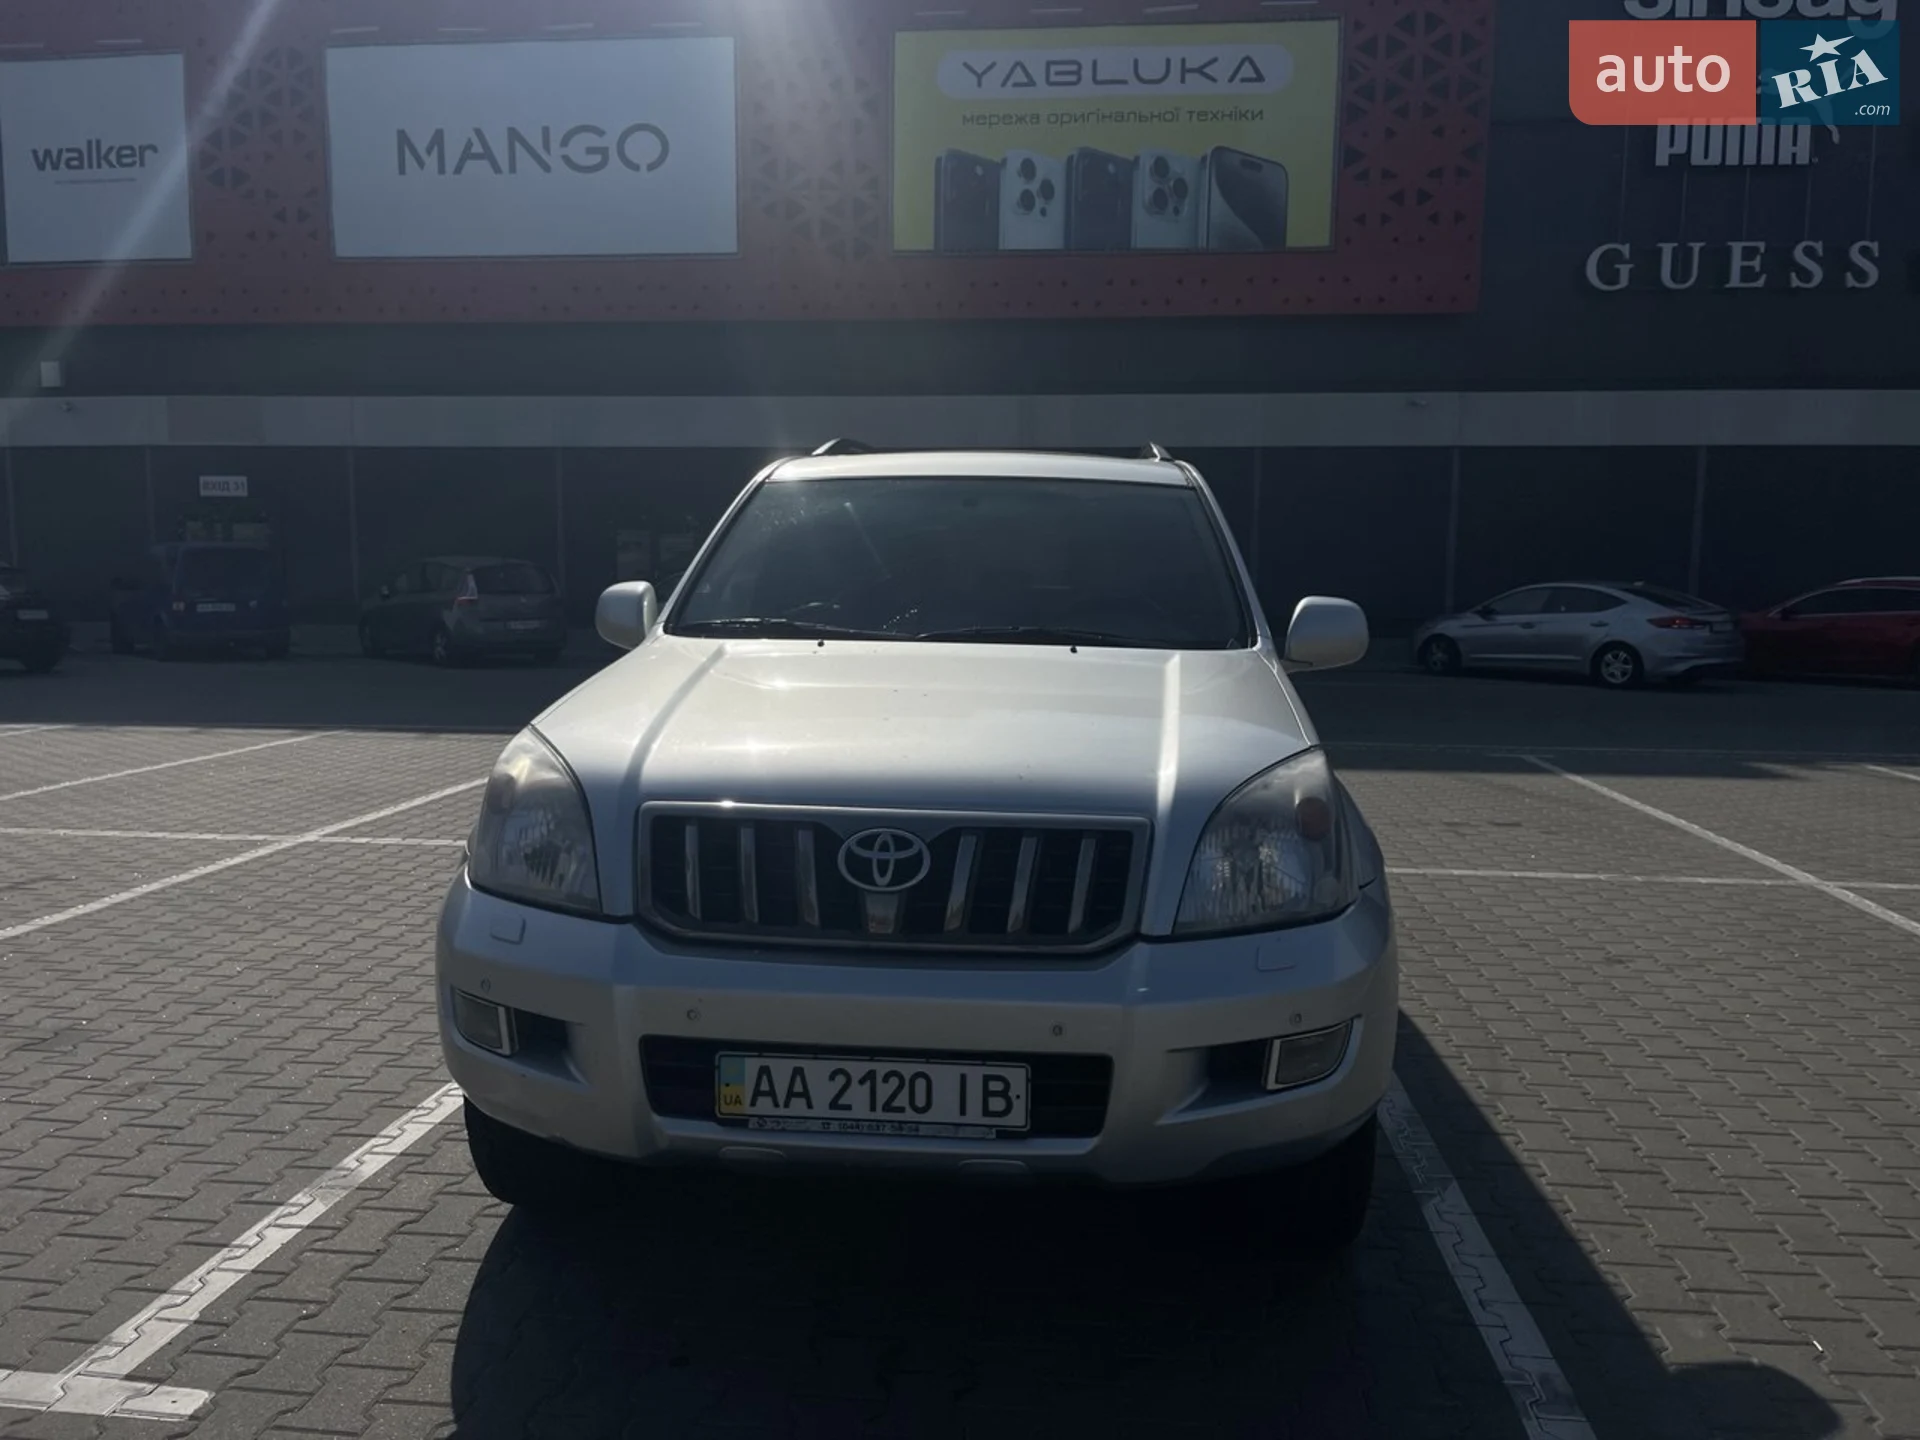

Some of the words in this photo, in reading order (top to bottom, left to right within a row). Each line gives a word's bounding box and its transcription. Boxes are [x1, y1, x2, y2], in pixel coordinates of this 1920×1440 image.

[963, 54, 1266, 88] YABLUKA
[962, 112, 1041, 129] мережа
[1047, 107, 1182, 128] оригінальної
[1186, 106, 1265, 123] техніки
[30, 139, 158, 173] walker
[395, 123, 670, 177] MANGO
[1655, 118, 1813, 167] PUMA
[1585, 240, 1880, 291] GUESS
[723, 1093, 743, 1107] UA
[749, 1064, 814, 1110] AA
[828, 1067, 933, 1115] 2120
[959, 1073, 1014, 1119] IB
